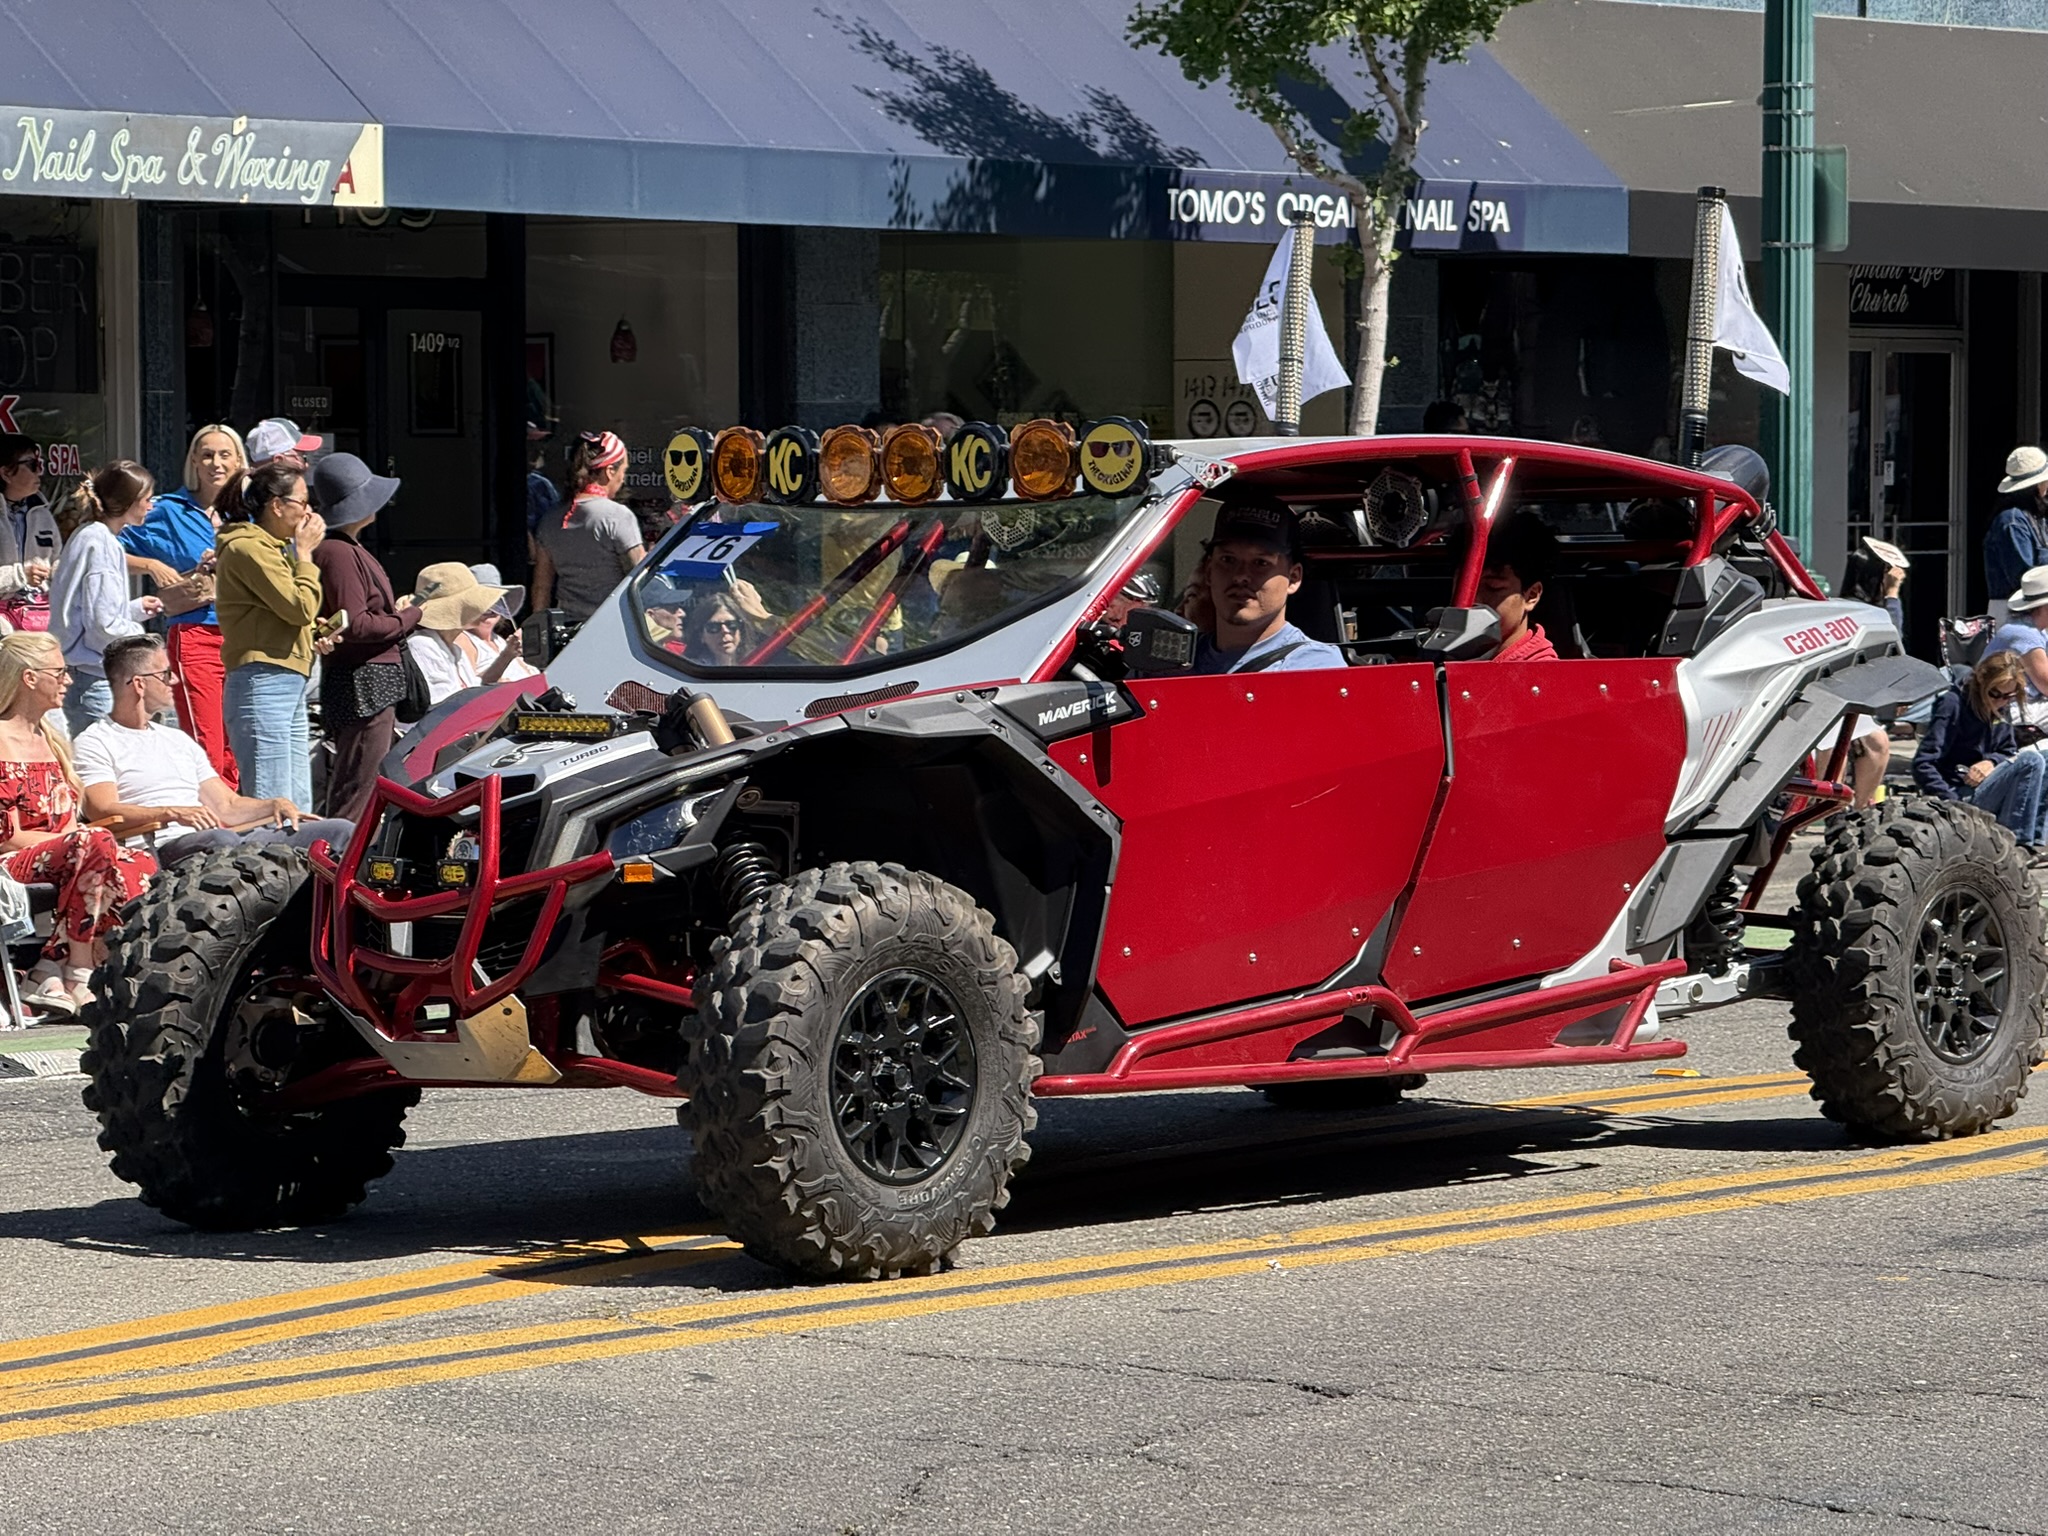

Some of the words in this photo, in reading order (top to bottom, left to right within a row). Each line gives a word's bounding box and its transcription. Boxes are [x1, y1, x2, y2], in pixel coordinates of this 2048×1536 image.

[2, 116, 96, 182] Nail
[102, 128, 167, 195] Spa
[177, 125, 208, 185] &
[211, 131, 331, 205] Waxing
[1167, 187, 1266, 226] TOMO'S
[1276, 191, 1373, 229] ORGA
[1404, 198, 1458, 232] NAIL
[1466, 199, 1511, 233] SPA
[1850, 282, 1910, 313] Church
[410, 332, 445, 353] 1409
[291, 396, 328, 409] CLOSED
[48, 443, 81, 476] SPA
[769, 438, 803, 495] KC
[951, 433, 992, 493] KC
[1097, 458, 1135, 485] ORIGINAL
[688, 534, 742, 560] 76
[1782, 615, 1859, 655] can-am
[1038, 690, 1117, 726] MAVERICK
[559, 744, 610, 767] TURBO
